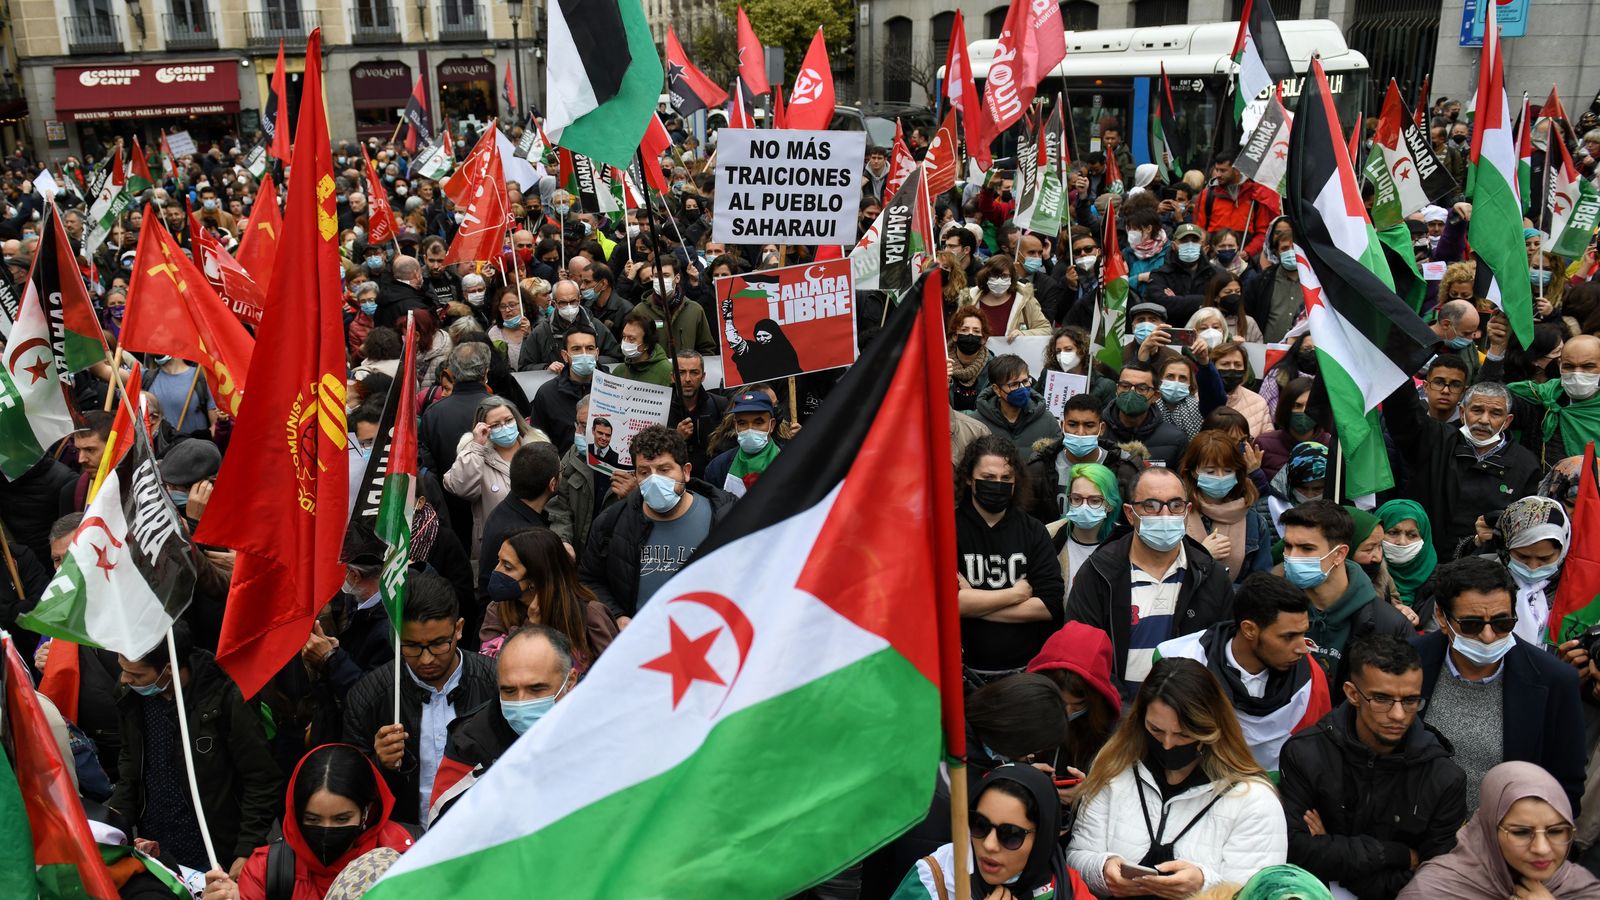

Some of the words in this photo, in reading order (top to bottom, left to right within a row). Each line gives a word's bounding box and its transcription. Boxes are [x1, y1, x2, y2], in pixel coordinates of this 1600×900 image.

[91, 69, 140, 78] CORNER
[167, 65, 215, 75] CORNER
[176, 74, 206, 82] CAFE
[100, 77, 131, 85] CAFE
[113, 110, 132, 118] TAPAS
[136, 108, 162, 117] PAELLAS
[166, 107, 187, 115] PIZZAS
[190, 105, 224, 113] ENSALADAS
[750, 140, 780, 159] NO
[786, 137, 831, 160] MÁS
[725, 166, 851, 187] TRAICIONES
[1366, 156, 1395, 206] LLIURE
[728, 192, 755, 210] AL
[762, 193, 843, 212] PUEBLO
[732, 218, 836, 237] SAHARAUI
[766, 274, 850, 303] SAHARA
[768, 290, 851, 326] LIBRE
[963, 552, 1028, 589] USC
